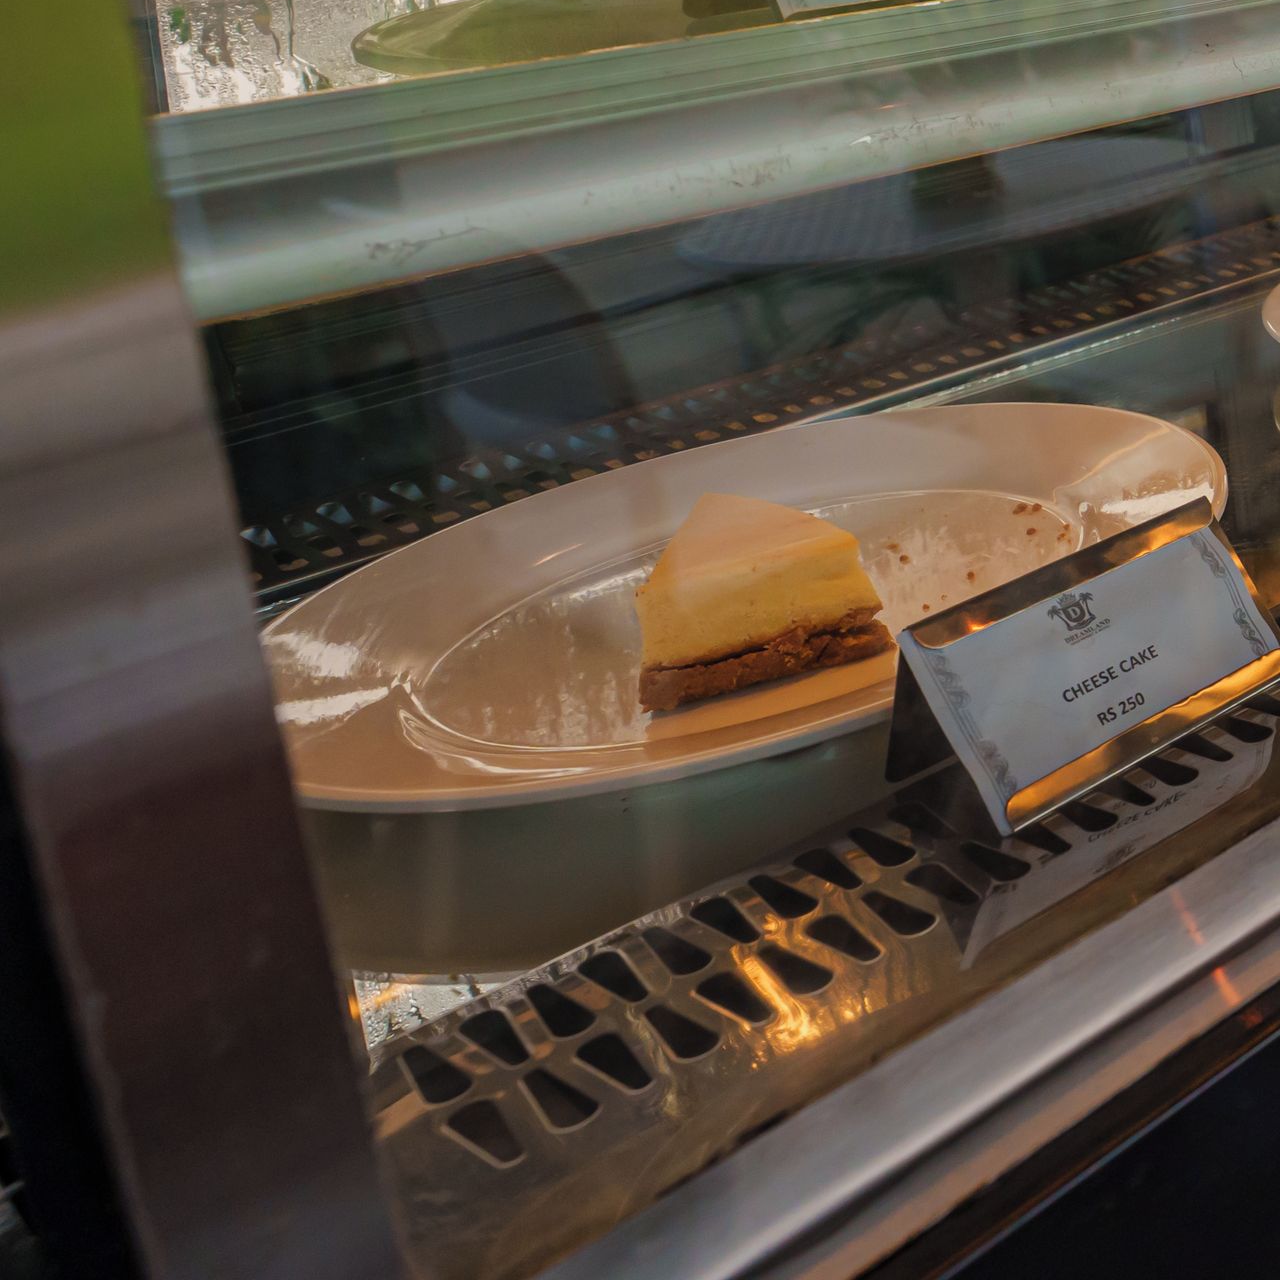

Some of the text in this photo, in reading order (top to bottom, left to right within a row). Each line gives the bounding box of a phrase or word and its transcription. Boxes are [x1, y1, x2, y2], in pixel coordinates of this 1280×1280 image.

[1064, 618, 1111, 645] DREAMLAND
[1062, 644, 1159, 703] CHEESE CAKE
[1097, 692, 1146, 726] RS 250
